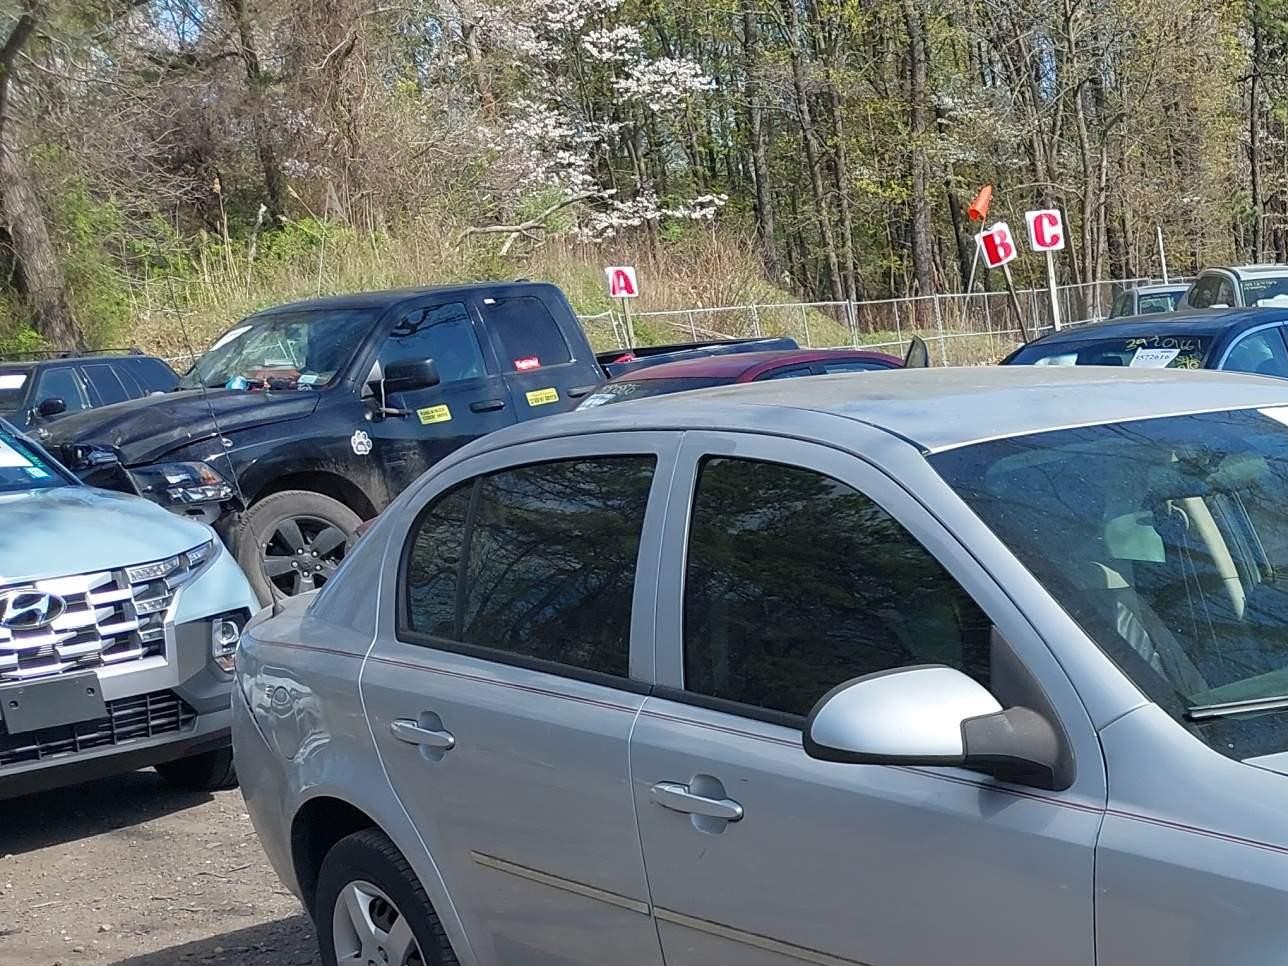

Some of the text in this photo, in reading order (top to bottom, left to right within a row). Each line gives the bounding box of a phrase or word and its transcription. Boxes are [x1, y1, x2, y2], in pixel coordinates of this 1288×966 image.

[982, 229, 1012, 265] B
[1034, 213, 1060, 248] C
[612, 270, 634, 295] A
